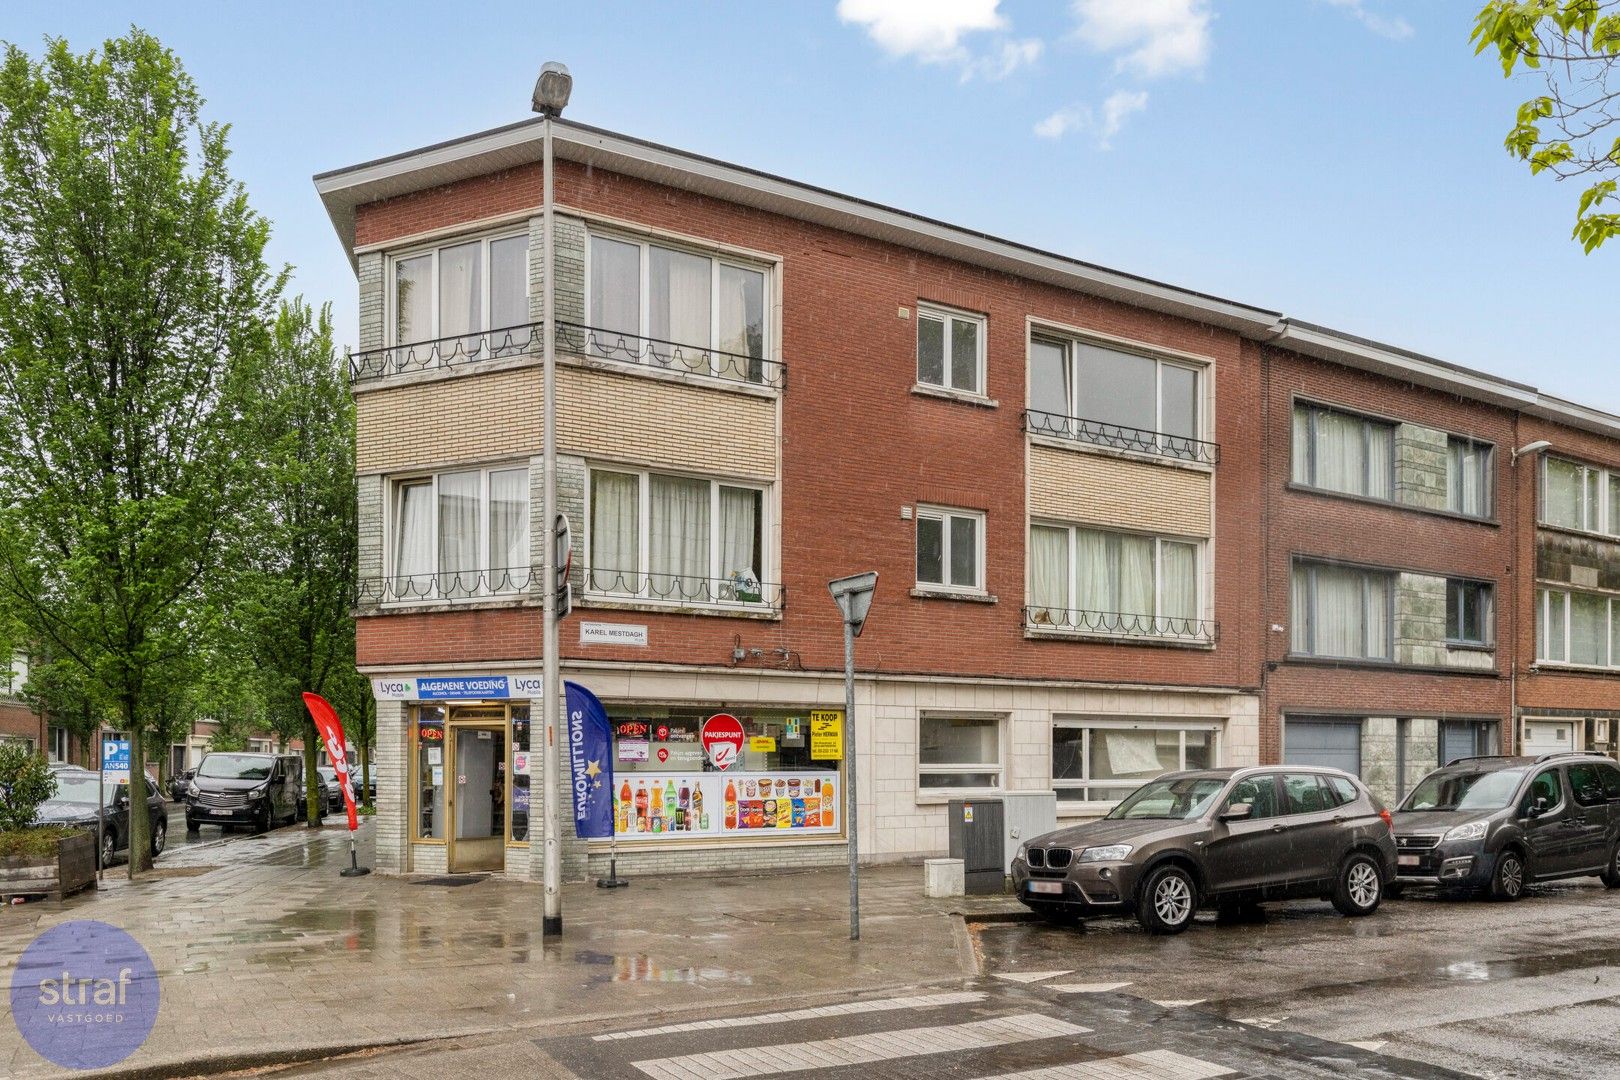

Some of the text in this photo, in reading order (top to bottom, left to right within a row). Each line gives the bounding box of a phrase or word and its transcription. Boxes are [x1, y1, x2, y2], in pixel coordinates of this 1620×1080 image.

[380, 682, 403, 693] Lyca
[420, 679, 505, 691] ALGEMENE VOEDING
[515, 678, 541, 692] Lyca
[812, 713, 838, 721] TE KOOP
[421, 728, 443, 740] OPEN
[620, 723, 648, 736] OPEN
[104, 742, 119, 760] P
